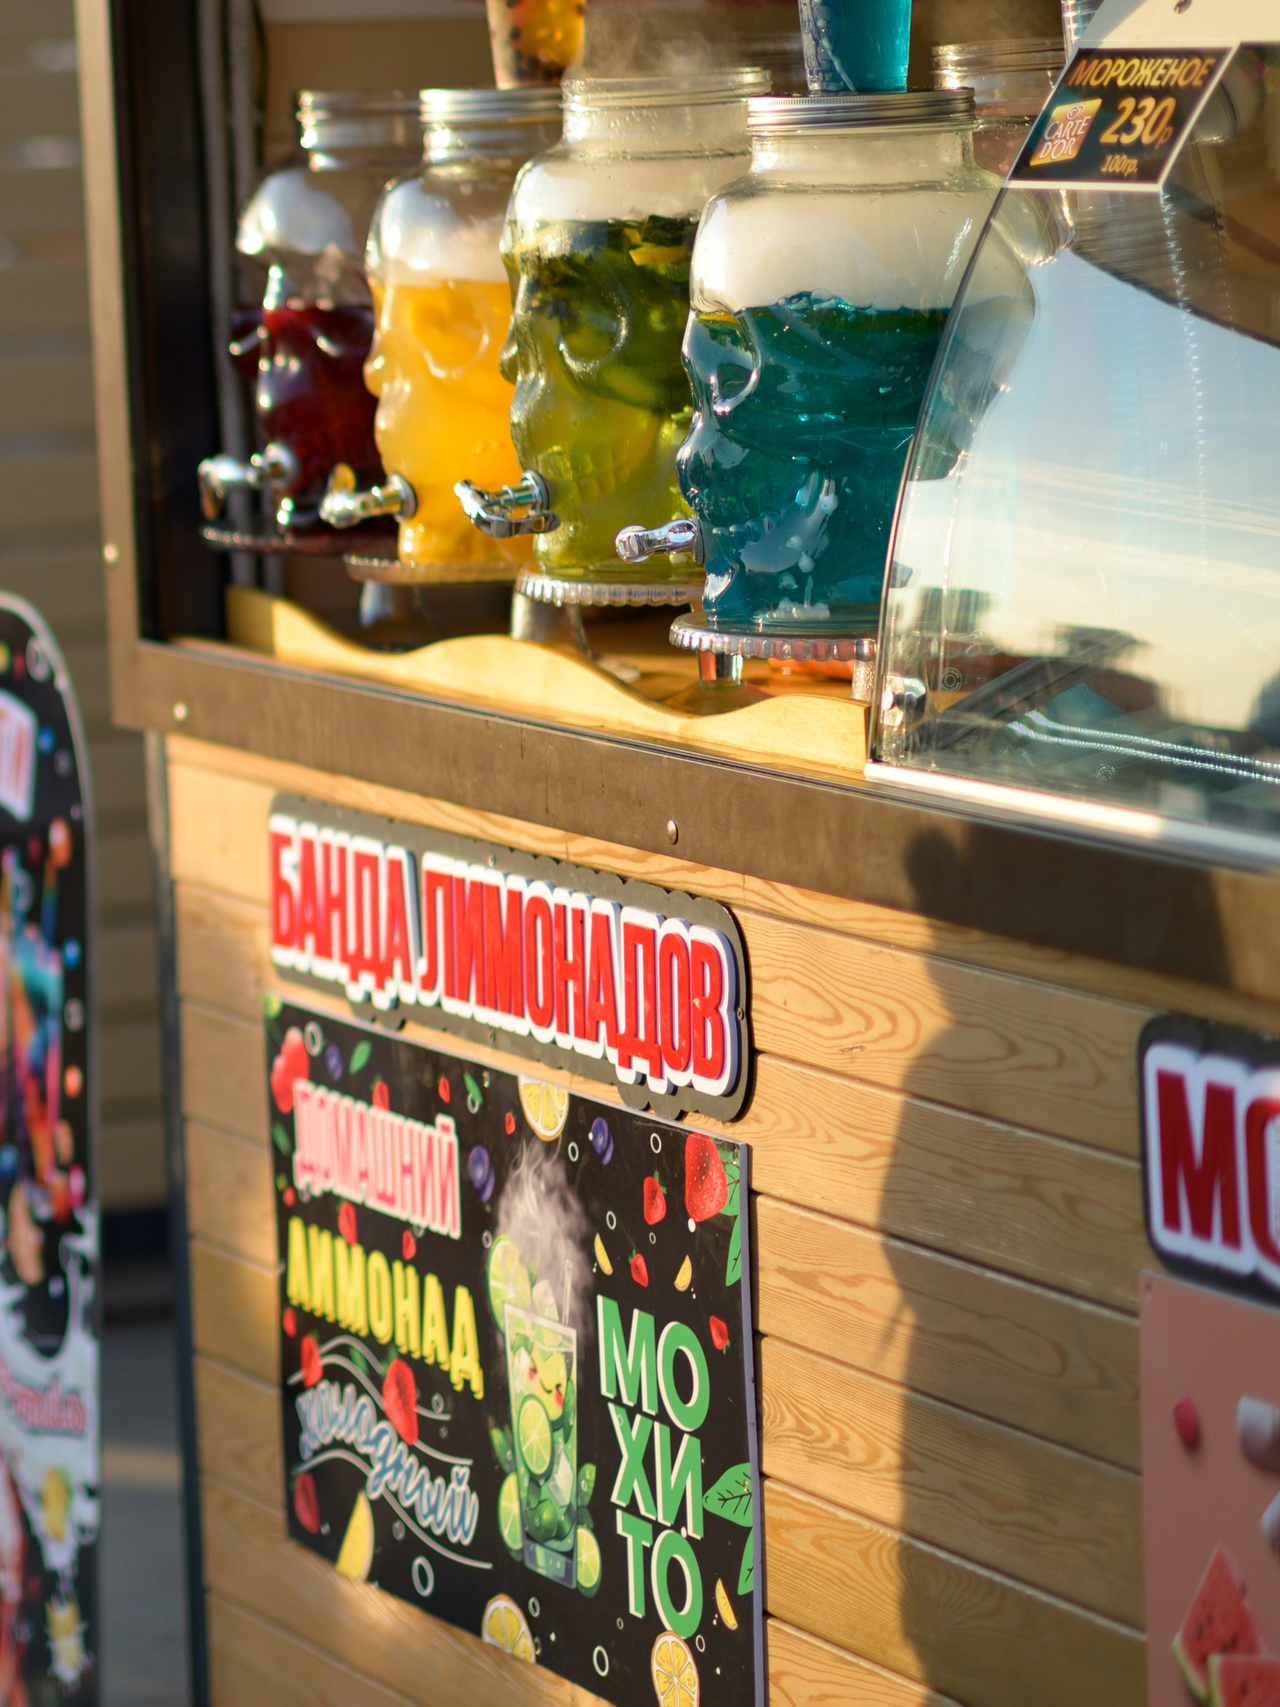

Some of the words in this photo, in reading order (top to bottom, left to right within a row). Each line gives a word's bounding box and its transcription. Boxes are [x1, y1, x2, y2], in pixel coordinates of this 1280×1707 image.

[1043, 116, 1091, 141] CARTE
[1067, 57, 1216, 87] МОРОЖЕНОЕ
[269, 824, 418, 1000] БАНДА
[420, 863, 726, 1084] ЛИМОНАДОВ
[294, 1078, 461, 1239] ДОМАШНИЙ
[287, 1216, 484, 1400] ЛИМОНАД
